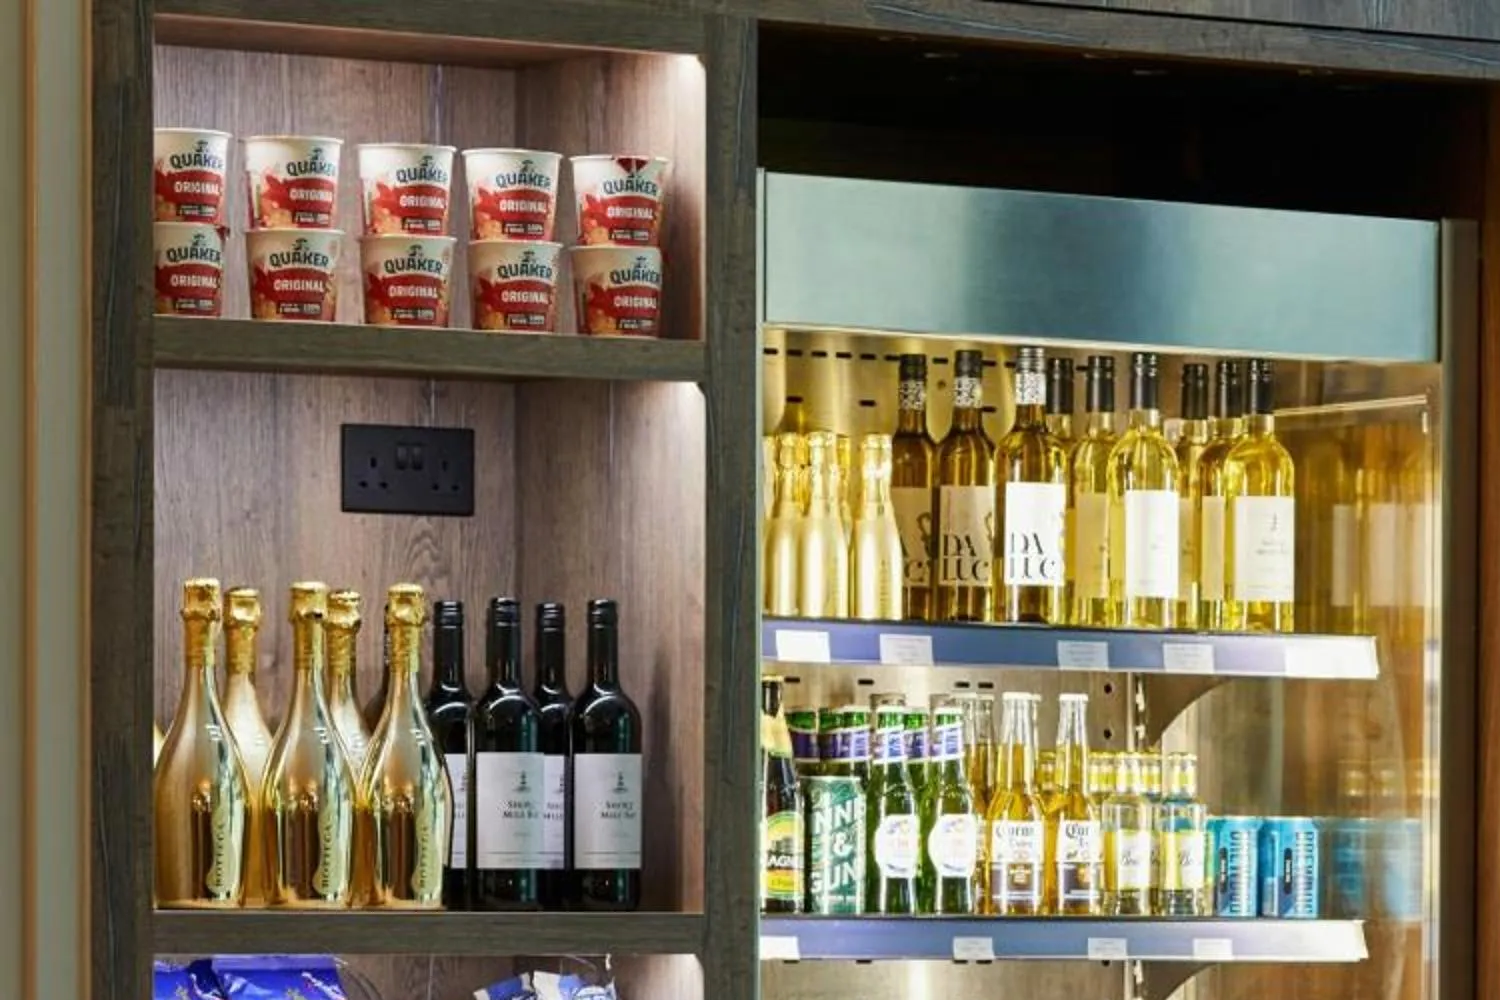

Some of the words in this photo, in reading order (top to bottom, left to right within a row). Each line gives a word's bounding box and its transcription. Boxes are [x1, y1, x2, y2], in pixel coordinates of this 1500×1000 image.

[602, 179, 658, 195] QUAKER
[500, 199, 546, 213] ORIGINAL
[607, 205, 653, 219] ORIGINAL
[269, 250, 329, 268] QUAKER
[384, 257, 442, 274] QUAKER
[497, 263, 552, 279] QUAKER
[273, 279, 324, 293] ORIGINAL
[388, 285, 438, 299] ORIGINAL
[501, 290, 548, 304] ORIGINAL
[943, 557, 990, 582] LUC
[1009, 556, 1056, 580] LUC
[810, 860, 859, 894] GUN
